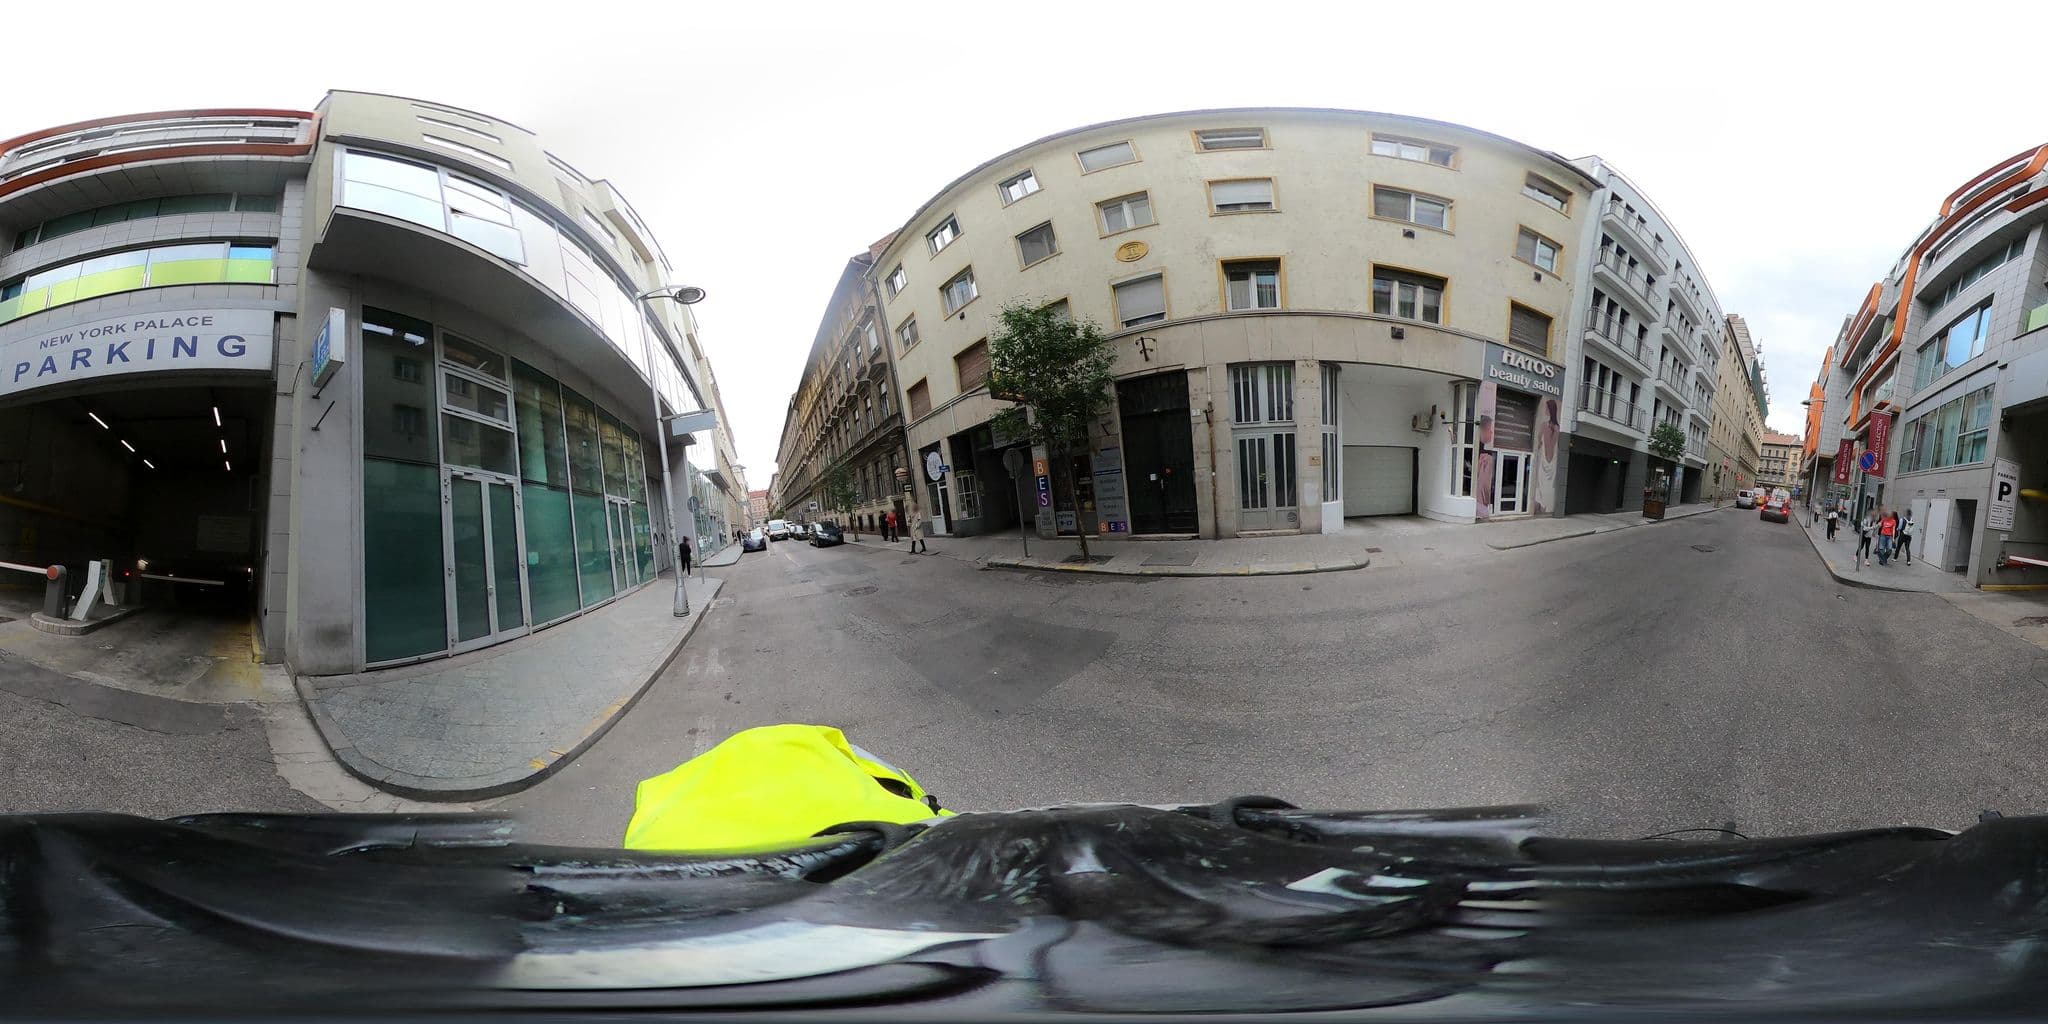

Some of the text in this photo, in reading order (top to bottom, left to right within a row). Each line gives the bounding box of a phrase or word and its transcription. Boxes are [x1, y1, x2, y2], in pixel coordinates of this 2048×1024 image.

[40, 316, 214, 349] NEW YORK PALACE
[14, 335, 246, 382] PARKING
[1502, 349, 1555, 378] HATOS
[1490, 364, 1560, 396] beauty salon
[1998, 481, 2012, 501] P
